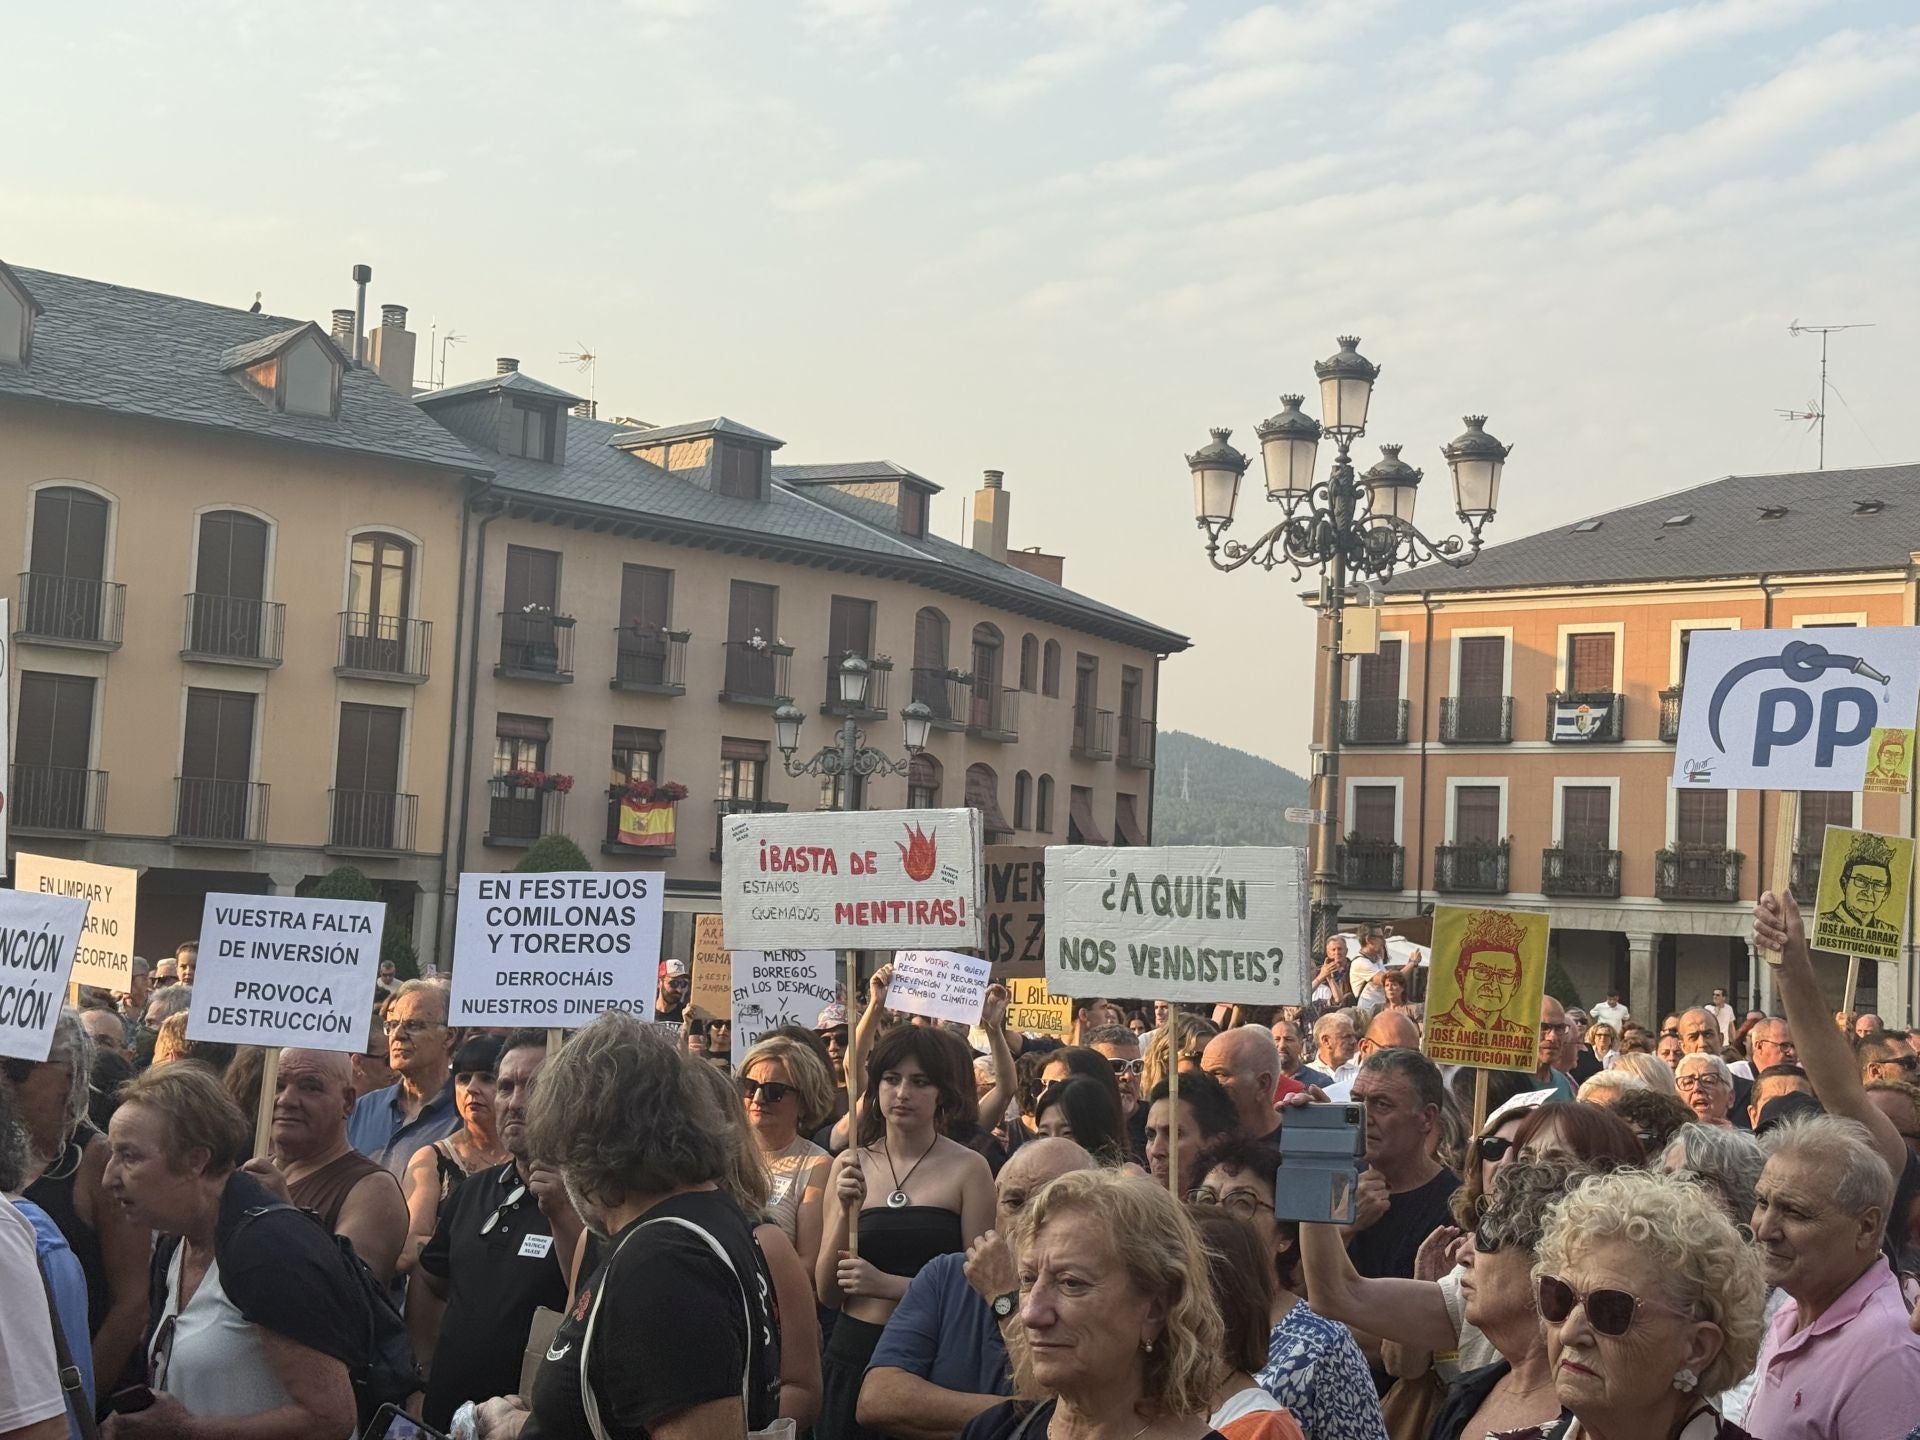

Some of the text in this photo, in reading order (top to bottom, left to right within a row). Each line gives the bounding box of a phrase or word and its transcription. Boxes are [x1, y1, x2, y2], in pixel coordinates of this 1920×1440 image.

[760, 839, 877, 875] ¡BASTA DE
[40, 876, 112, 903] EN LIMPIAR Y
[479, 879, 647, 899] EN FESTEJOS
[743, 880, 800, 894] ESTAMOS
[1102, 866, 1247, 920] ¿A QUIÉN
[215, 908, 372, 933] VUESTRA FALTA
[486, 906, 636, 927] COMILONAS
[752, 906, 819, 921] QUEMADOS
[835, 896, 966, 927] MENTIRAS!
[82, 916, 118, 937] AR NO
[1866, 929, 1899, 944] ARRANZ
[0, 922, 64, 973] NCIÓN
[219, 939, 359, 966] DE INVERSIÓN
[487, 933, 631, 954] Y TOREROS
[1883, 946, 1898, 958] YA!
[75, 947, 128, 971] ECORTAR
[763, 950, 806, 962] MENOS
[905, 952, 917, 961] NO
[925, 956, 949, 968] VOTAR
[1060, 937, 1283, 986] NOS VENDISTEIS?
[495, 968, 613, 986] DERROCHÁIS
[753, 966, 817, 978] BORREGOS
[898, 963, 932, 976] RECORTA
[234, 981, 333, 1006] PROVOCA
[733, 981, 836, 1004] EN LOS DESPACHOS
[892, 985, 903, 994] EL
[946, 984, 951, 992] Y
[0, 979, 52, 1031] CIÓN
[461, 999, 644, 1014] NUESTROS DINEROS
[778, 996, 788, 1011] Y
[208, 1006, 352, 1034] DESTRUCCIÓN
[765, 1011, 801, 1029] MÁS
[1018, 1008, 1062, 1031] PROTEGE
[1491, 1033, 1534, 1050] ARRANZ
[1514, 1054, 1533, 1067] YA!
